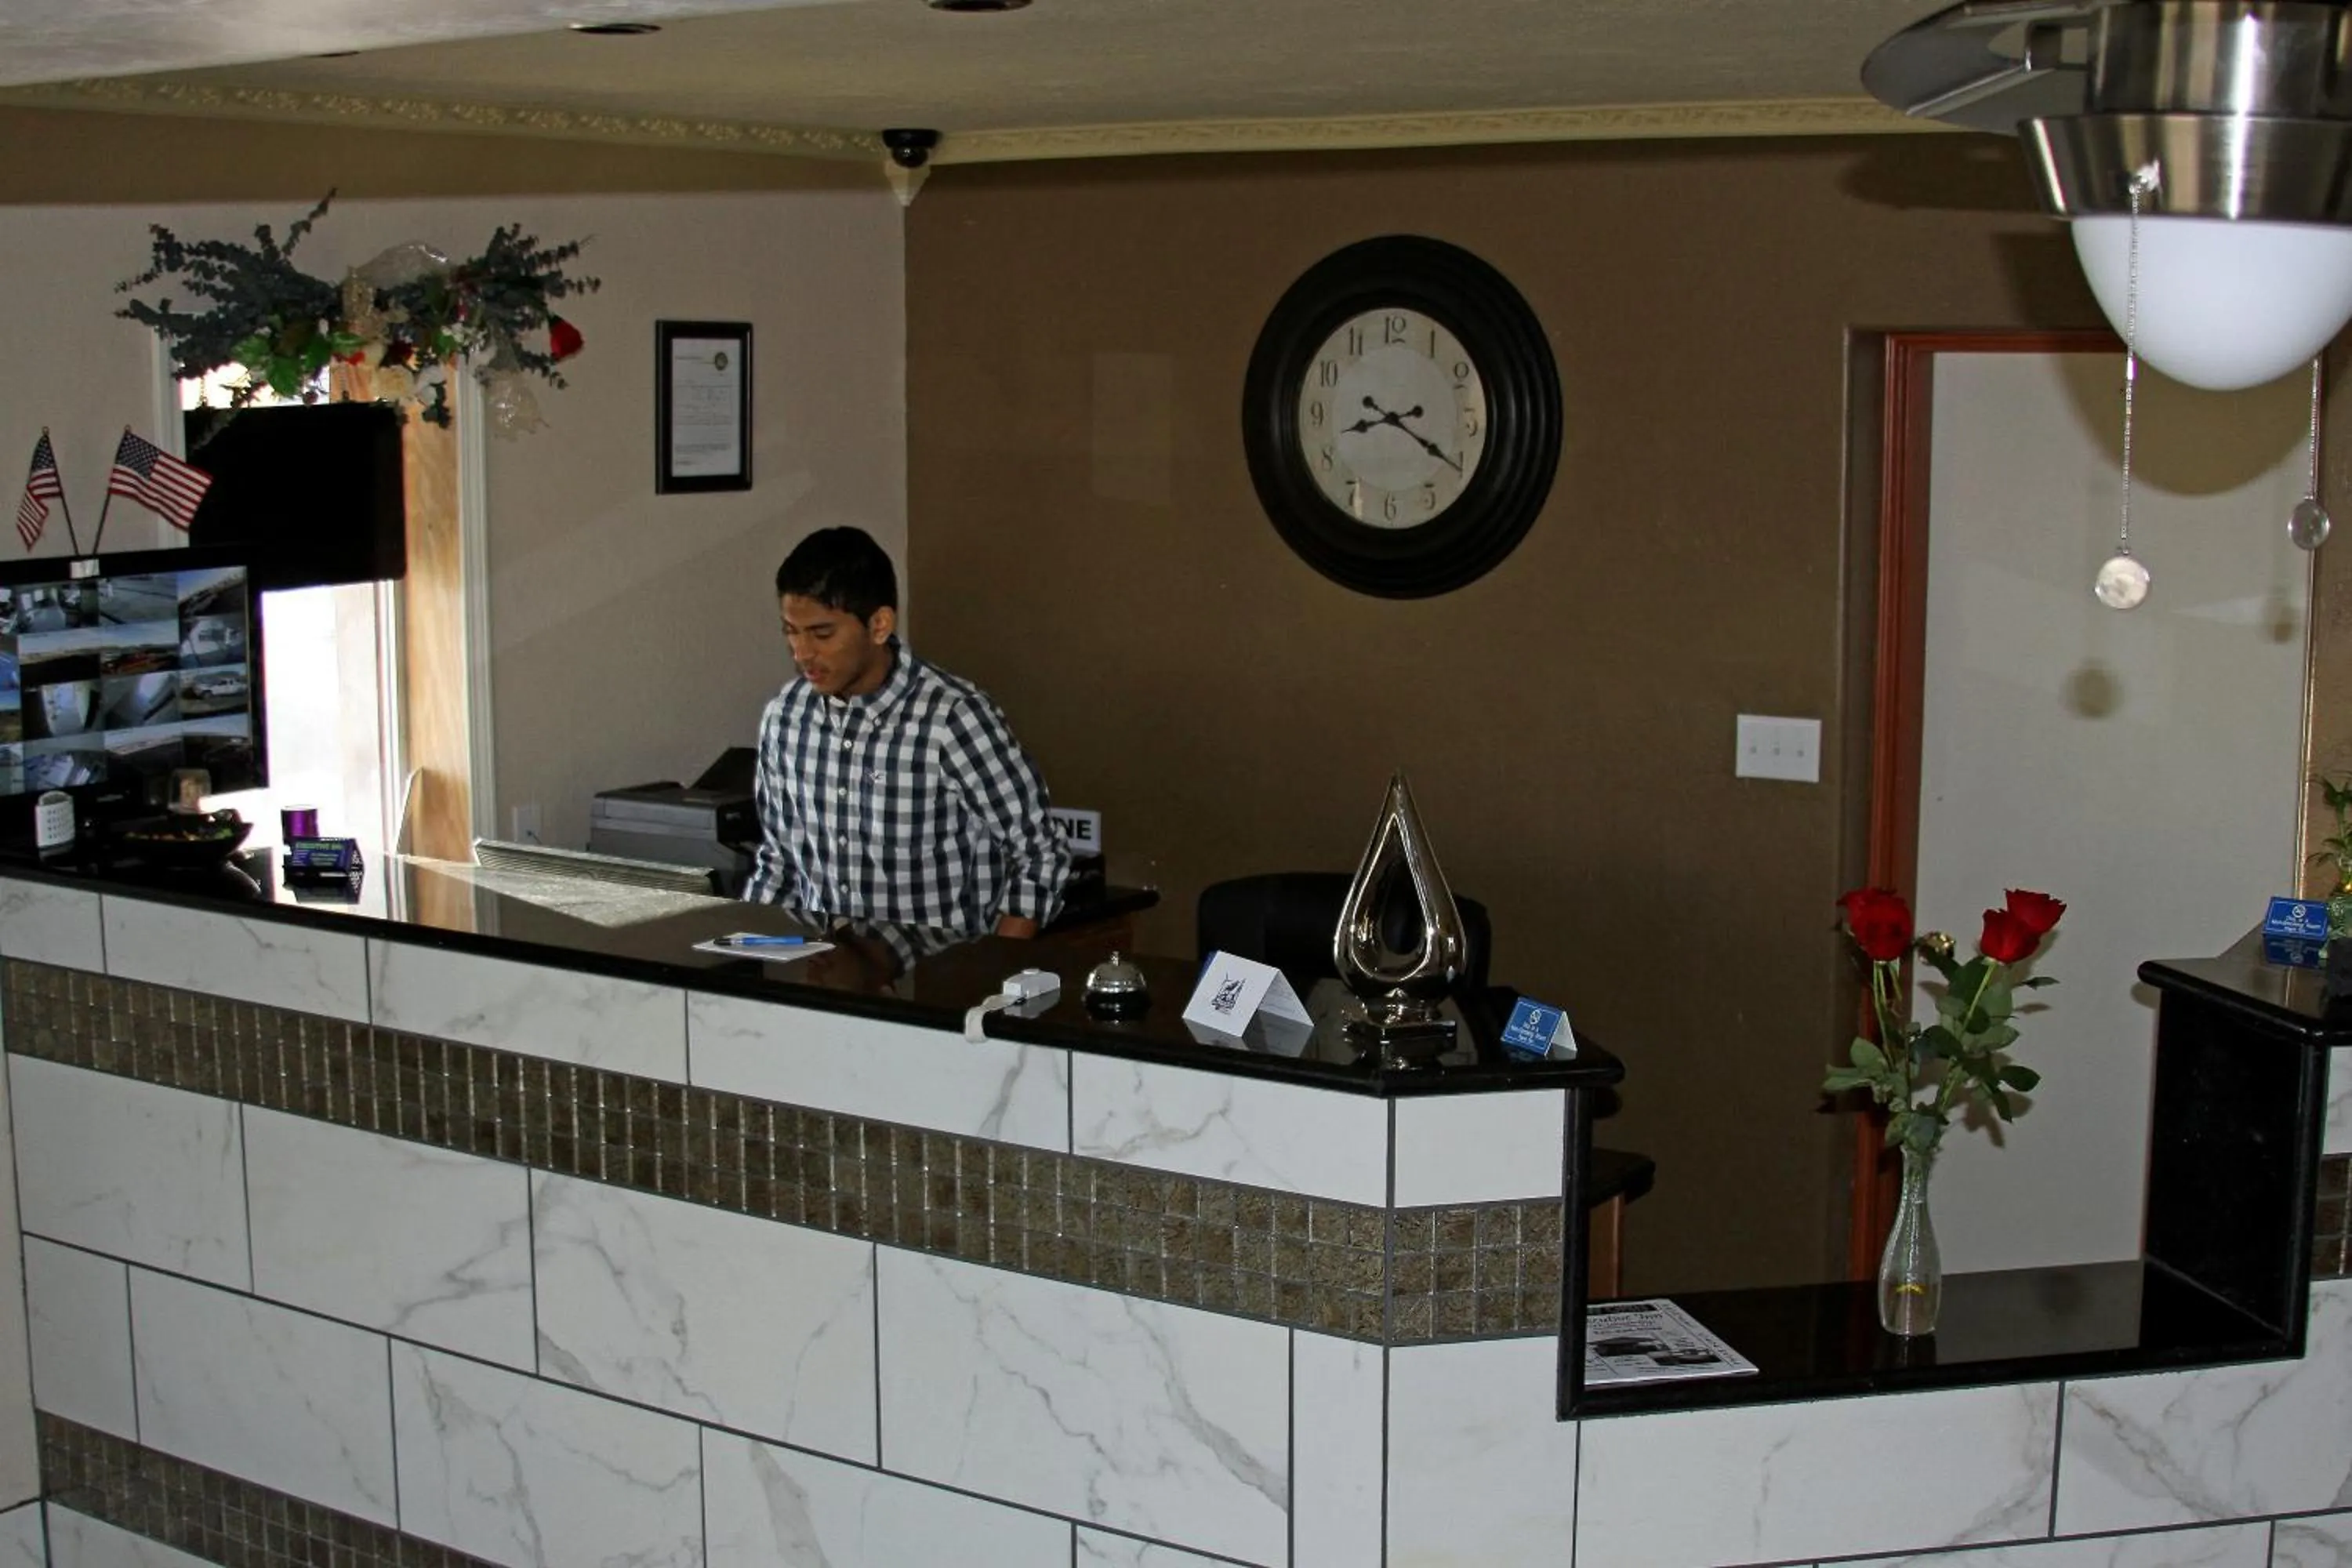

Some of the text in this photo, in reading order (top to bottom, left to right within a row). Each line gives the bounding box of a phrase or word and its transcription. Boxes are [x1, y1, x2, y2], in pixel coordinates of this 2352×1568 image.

[1348, 326, 1363, 355] 11
[1384, 316, 1406, 345] 12
[1429, 329, 1436, 358] 1
[1320, 359, 1338, 387] 10
[1453, 361, 1469, 390] 2
[1310, 402, 1324, 426] 9
[1322, 445, 1334, 471] 8
[1384, 492, 1398, 521] 6
[1423, 483, 1436, 510] 5
